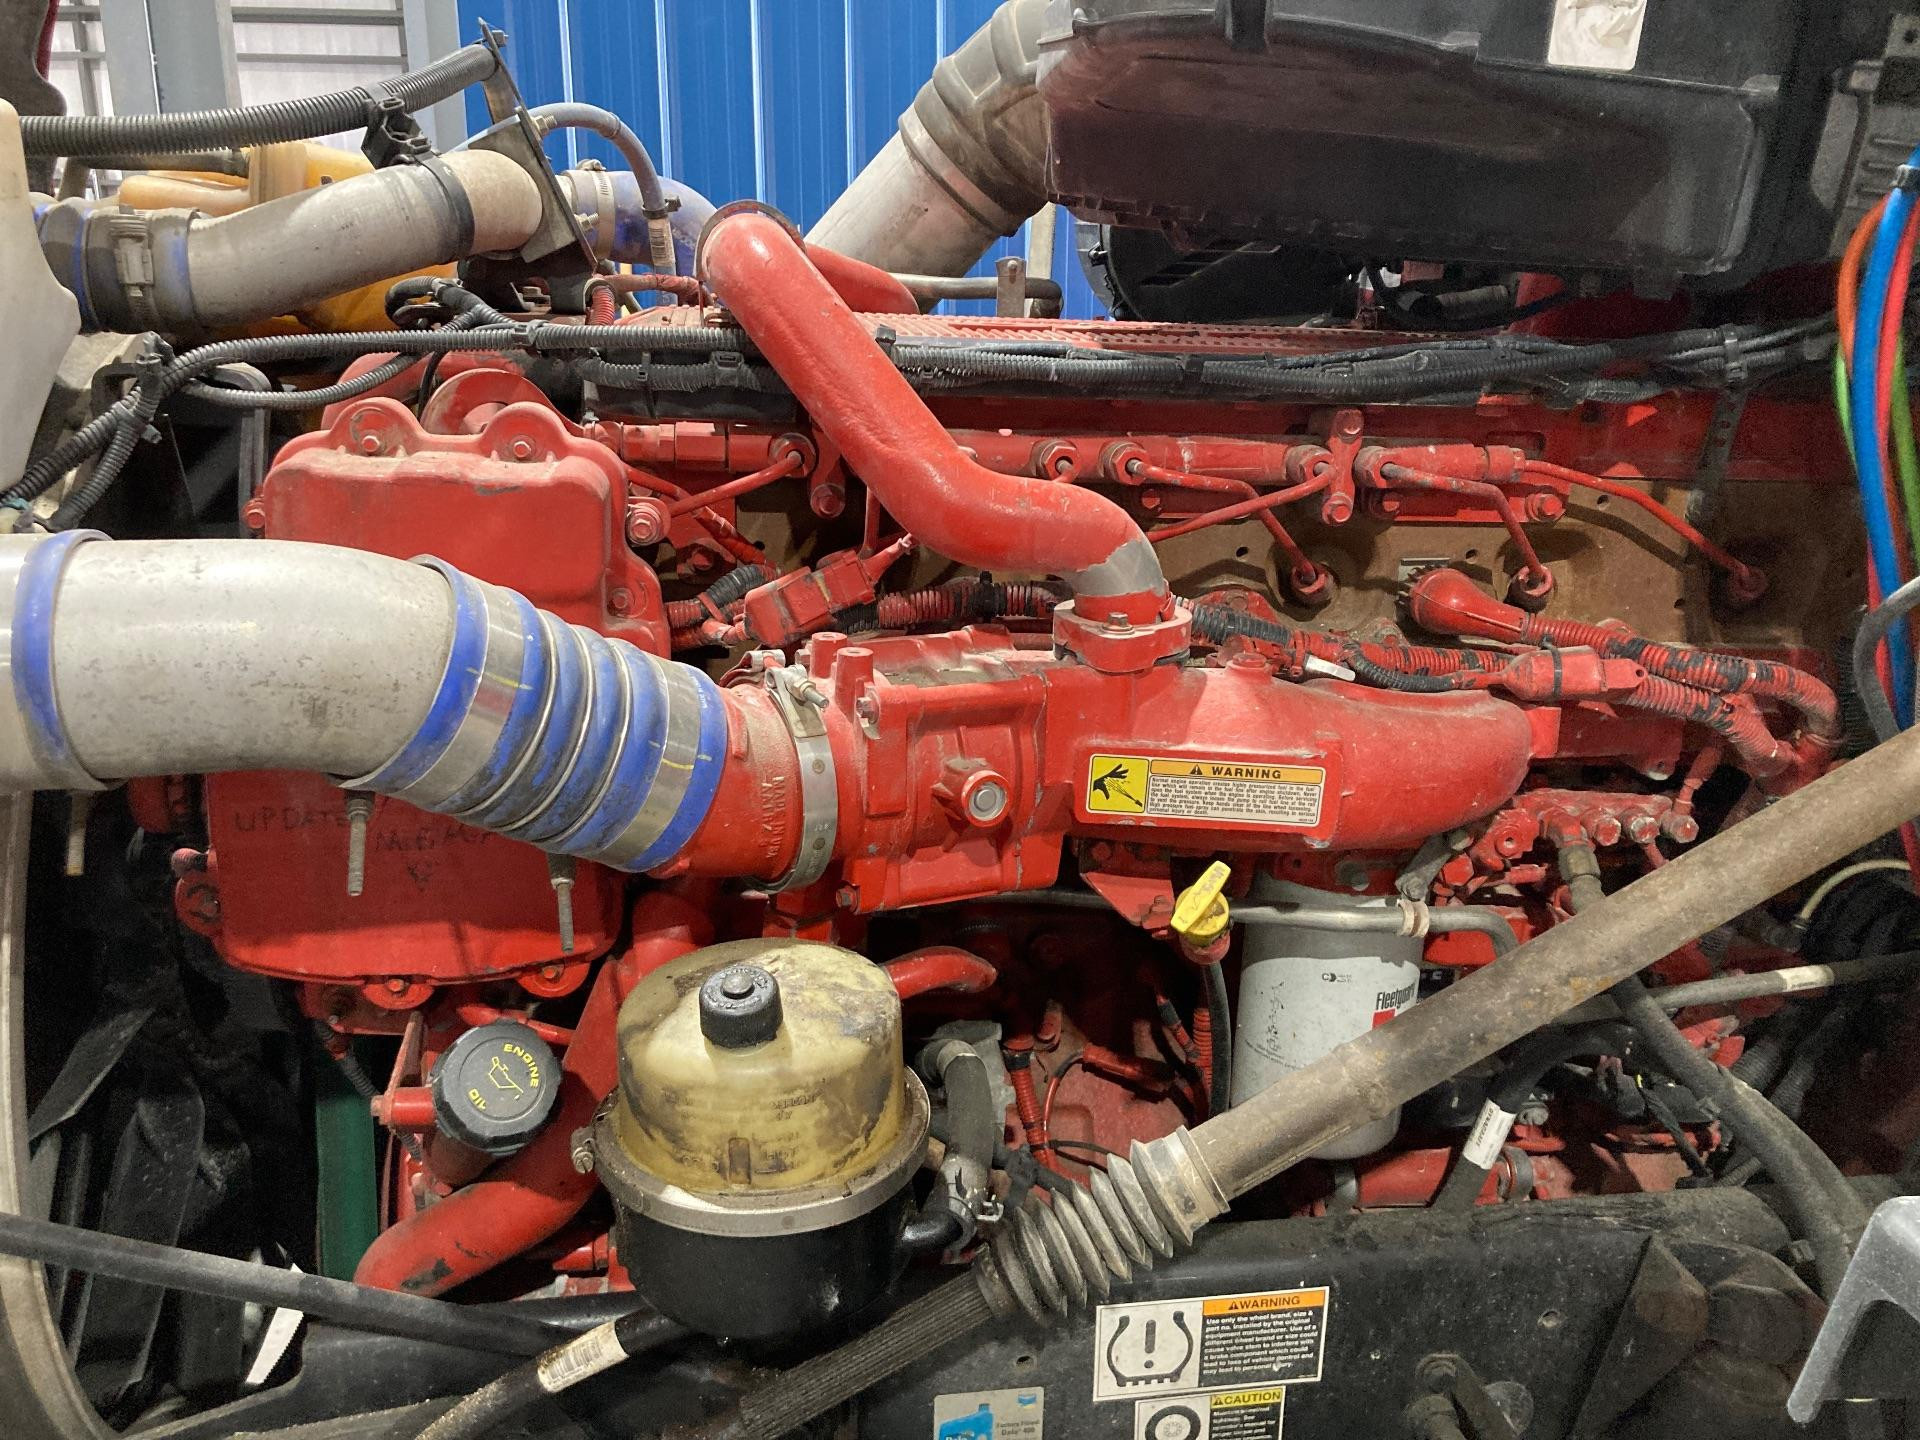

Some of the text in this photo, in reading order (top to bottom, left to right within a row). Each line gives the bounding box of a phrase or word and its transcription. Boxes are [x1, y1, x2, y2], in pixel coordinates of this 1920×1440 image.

[1212, 766, 1281, 780] WARNING
[503, 1043, 540, 1088] ENGINE
[468, 1088, 487, 1111] OIL
[1240, 1296, 1300, 1311] WARNING
[1205, 1325, 1220, 1333] part
[1233, 1321, 1262, 1329] installed
[1285, 1317, 1311, 1327] original
[1220, 1317, 1236, 1325] only
[1270, 1312, 1292, 1321] brand,
[1205, 1330, 1241, 1340] equipment
[1242, 1326, 1288, 1336] manufacturer.
[1204, 1338, 1233, 1346] different
[1230, 1349, 1268, 1359] component
[1251, 1355, 1275, 1363] vehicle
[1203, 1368, 1217, 1376] may
[1242, 1363, 1272, 1372] personal
[1224, 1392, 1280, 1405] CAUTION
